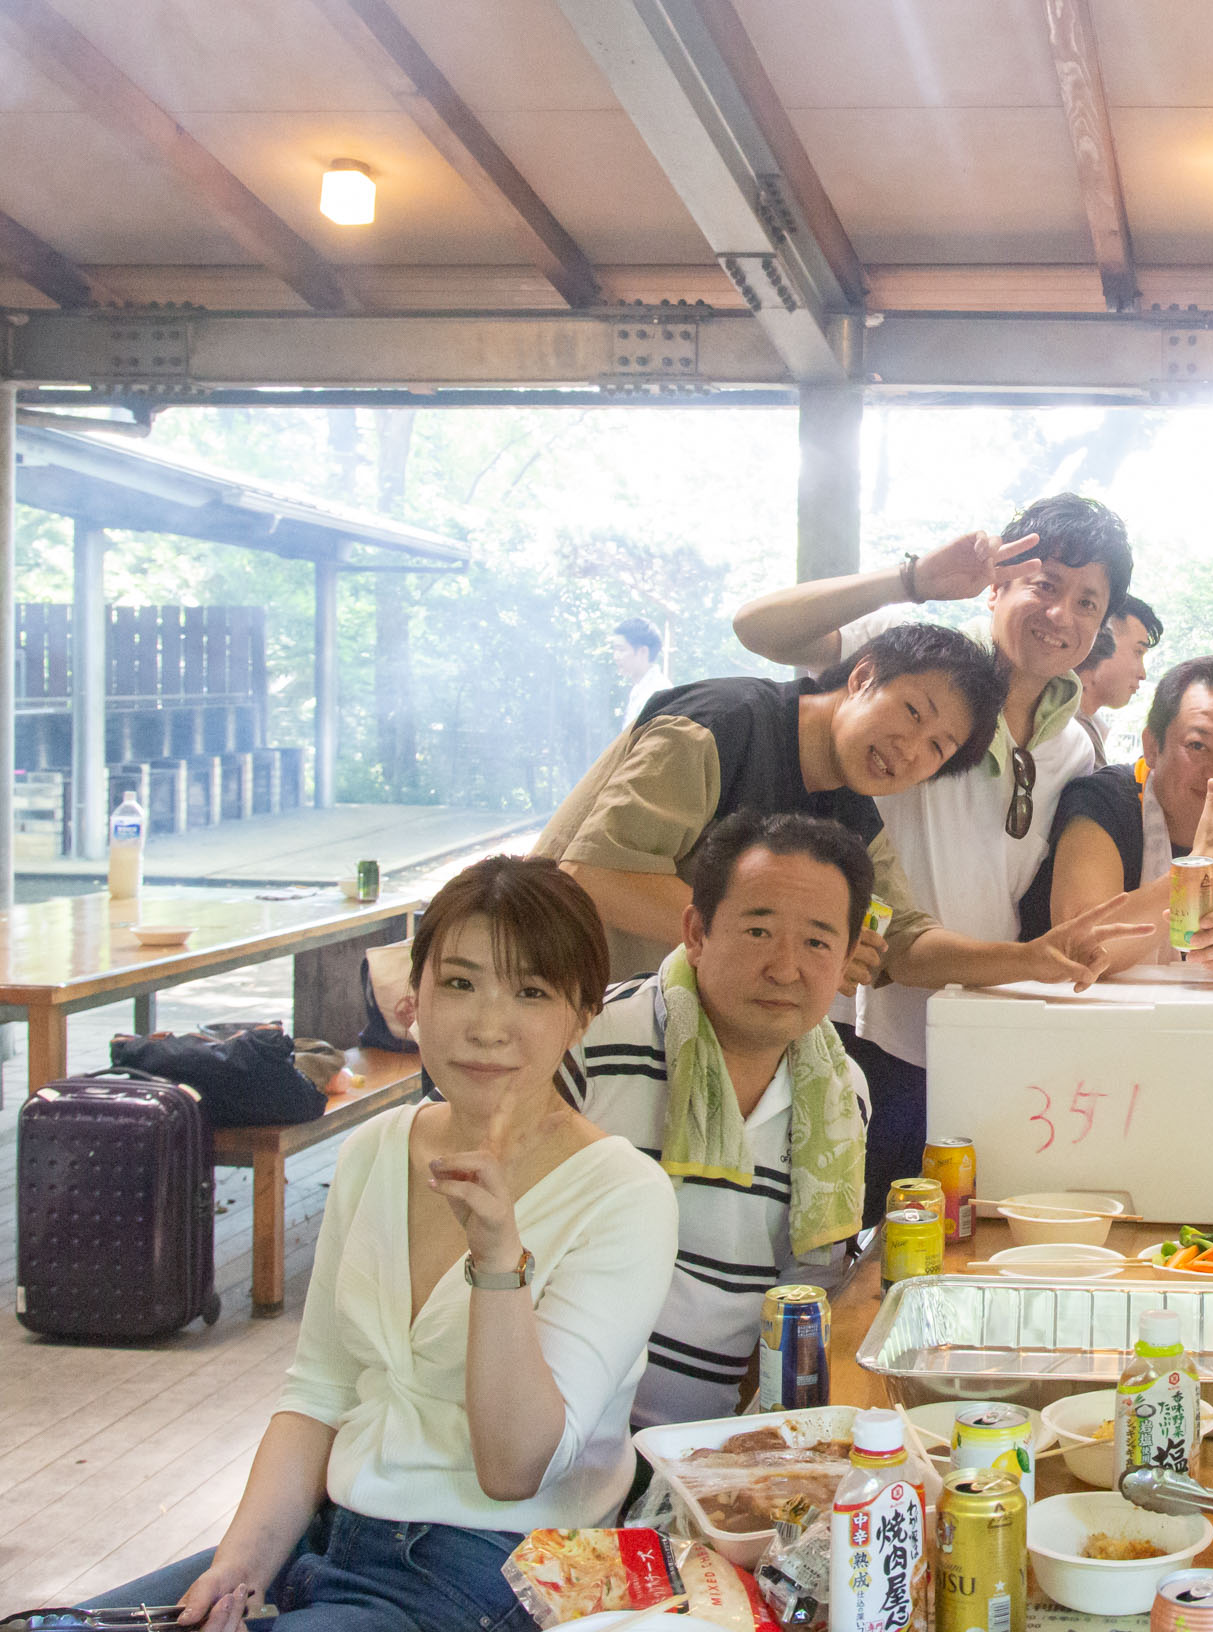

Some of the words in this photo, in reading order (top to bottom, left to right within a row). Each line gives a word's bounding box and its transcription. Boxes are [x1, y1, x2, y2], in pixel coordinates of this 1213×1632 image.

[1026, 1080, 1141, 1153] 351
[853, 1512, 868, 1546] 中辛
[704, 1572, 723, 1607] MIXED
